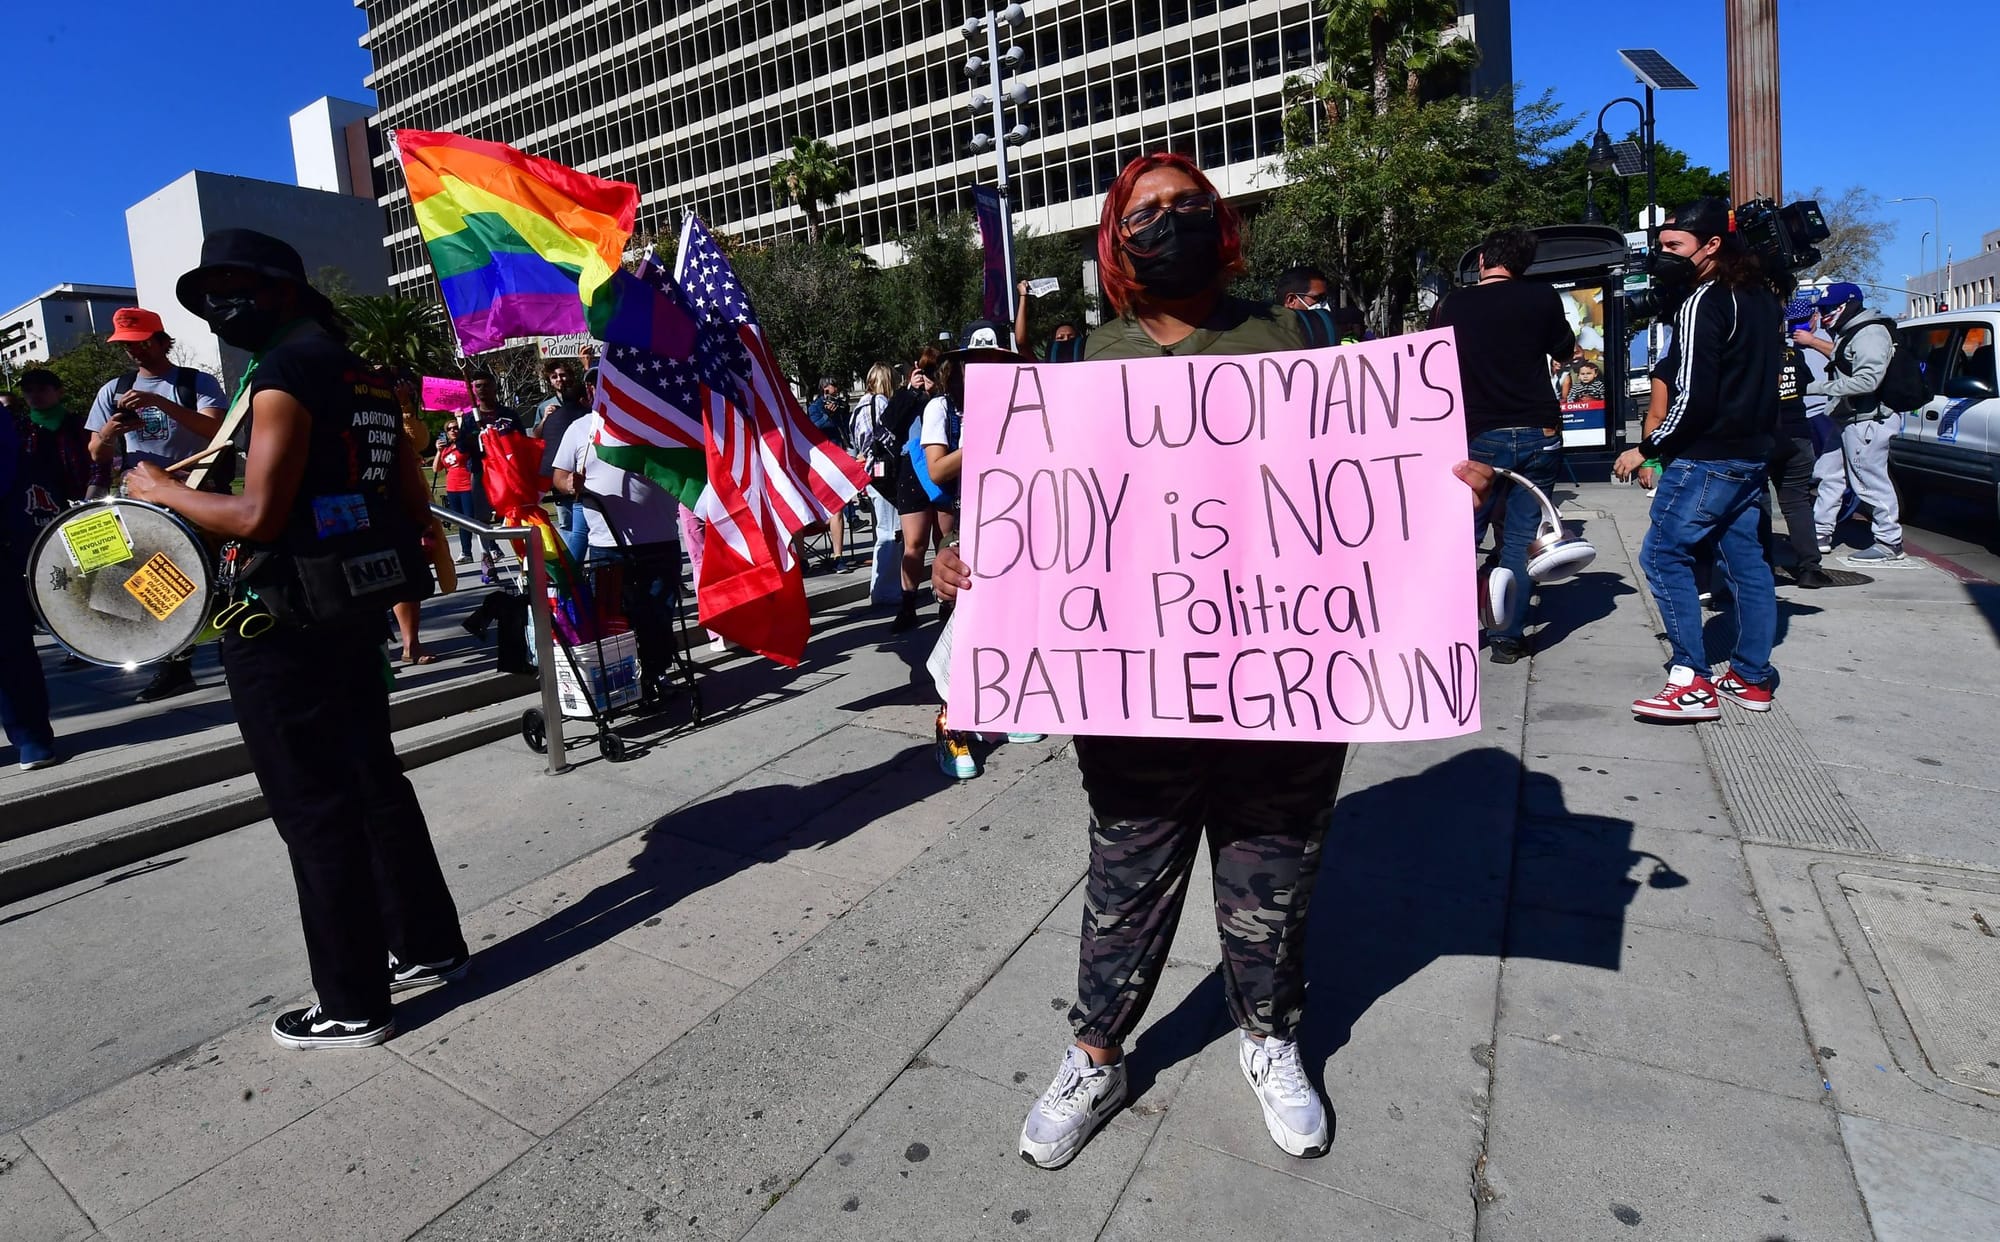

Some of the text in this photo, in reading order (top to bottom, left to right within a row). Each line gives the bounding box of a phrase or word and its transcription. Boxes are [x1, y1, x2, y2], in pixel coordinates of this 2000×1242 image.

[352, 411, 395, 428] ABORTION
[996, 340, 1454, 455] A WOMAN'S
[973, 453, 1423, 579] BODY is NOT
[1059, 561, 1380, 638] a Political
[973, 642, 1478, 731] BATTLEGROUND
